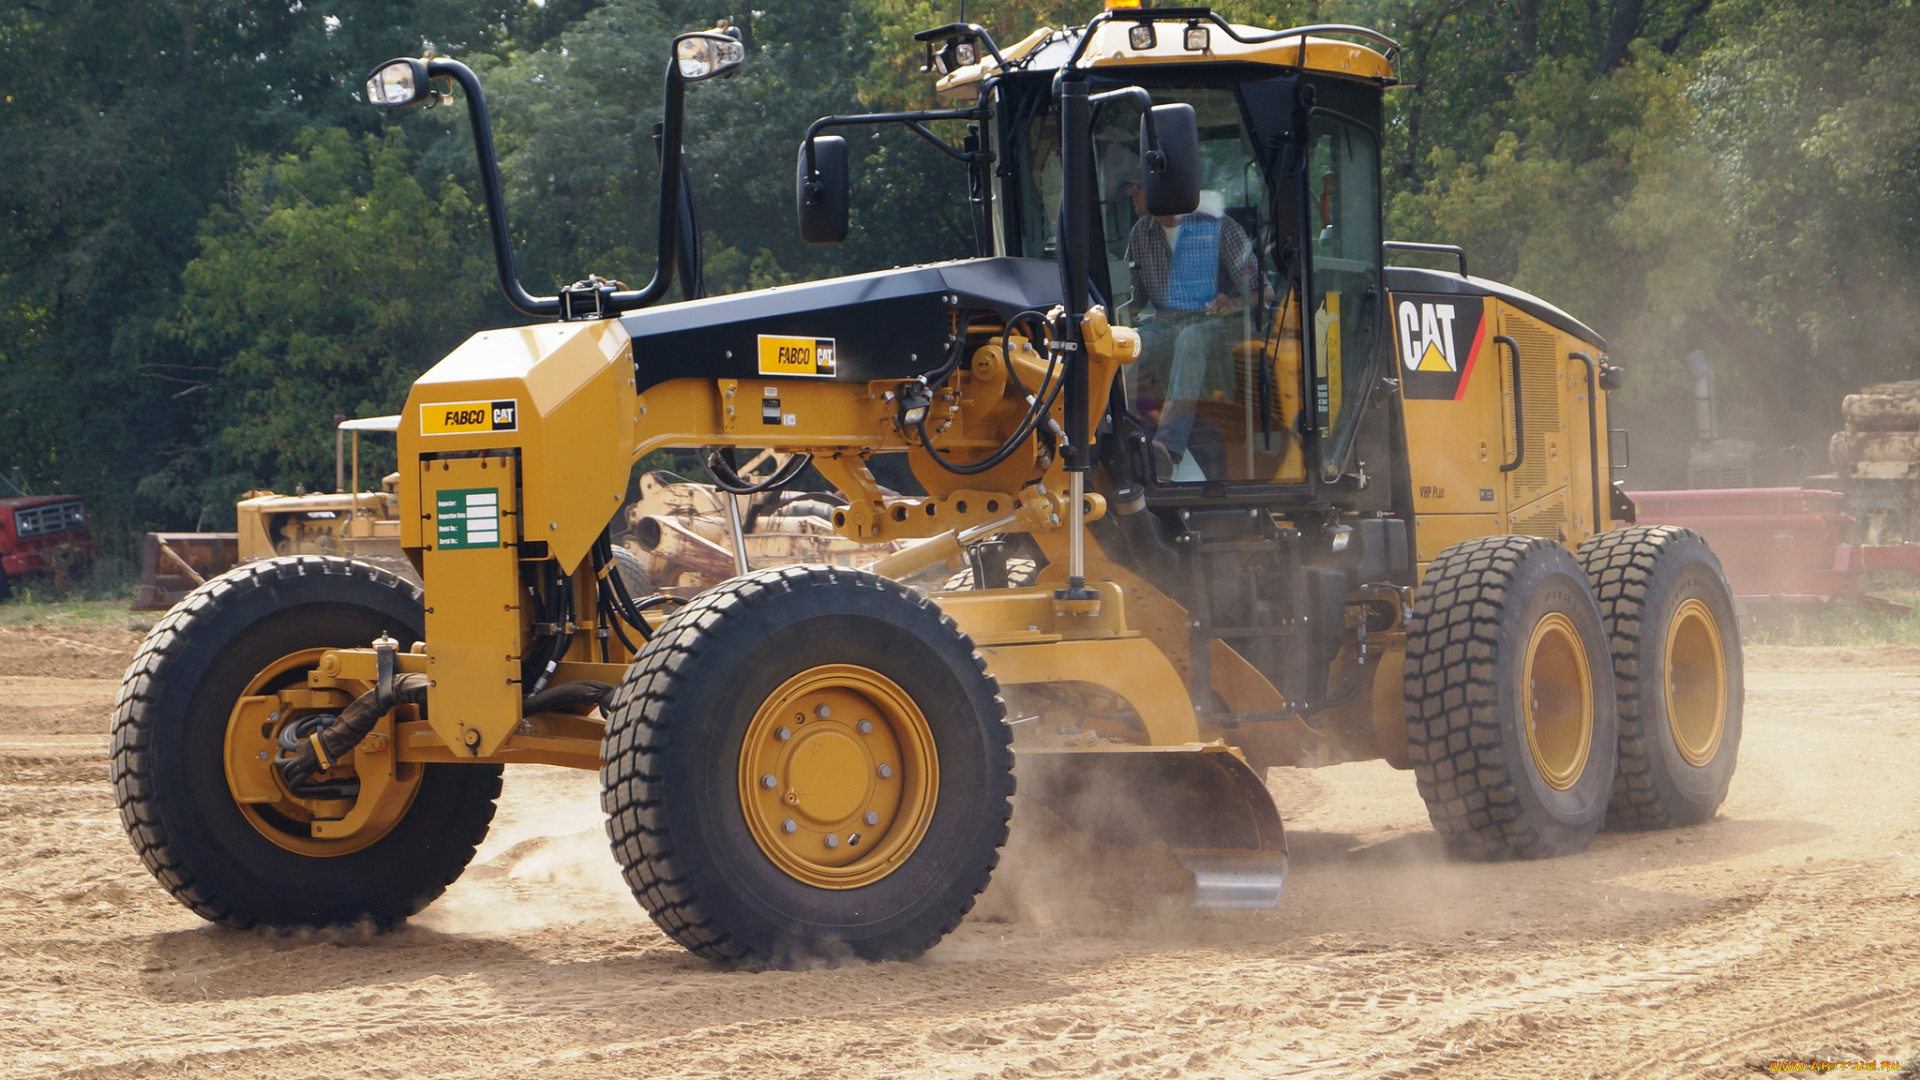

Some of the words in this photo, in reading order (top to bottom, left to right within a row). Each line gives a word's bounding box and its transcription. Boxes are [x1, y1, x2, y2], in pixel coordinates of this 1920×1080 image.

[1399, 301, 1457, 372] CAT
[778, 346, 810, 365] FABCO
[816, 348, 834, 366] CAT
[444, 409, 485, 426] FABCO
[493, 408, 514, 424] CAT
